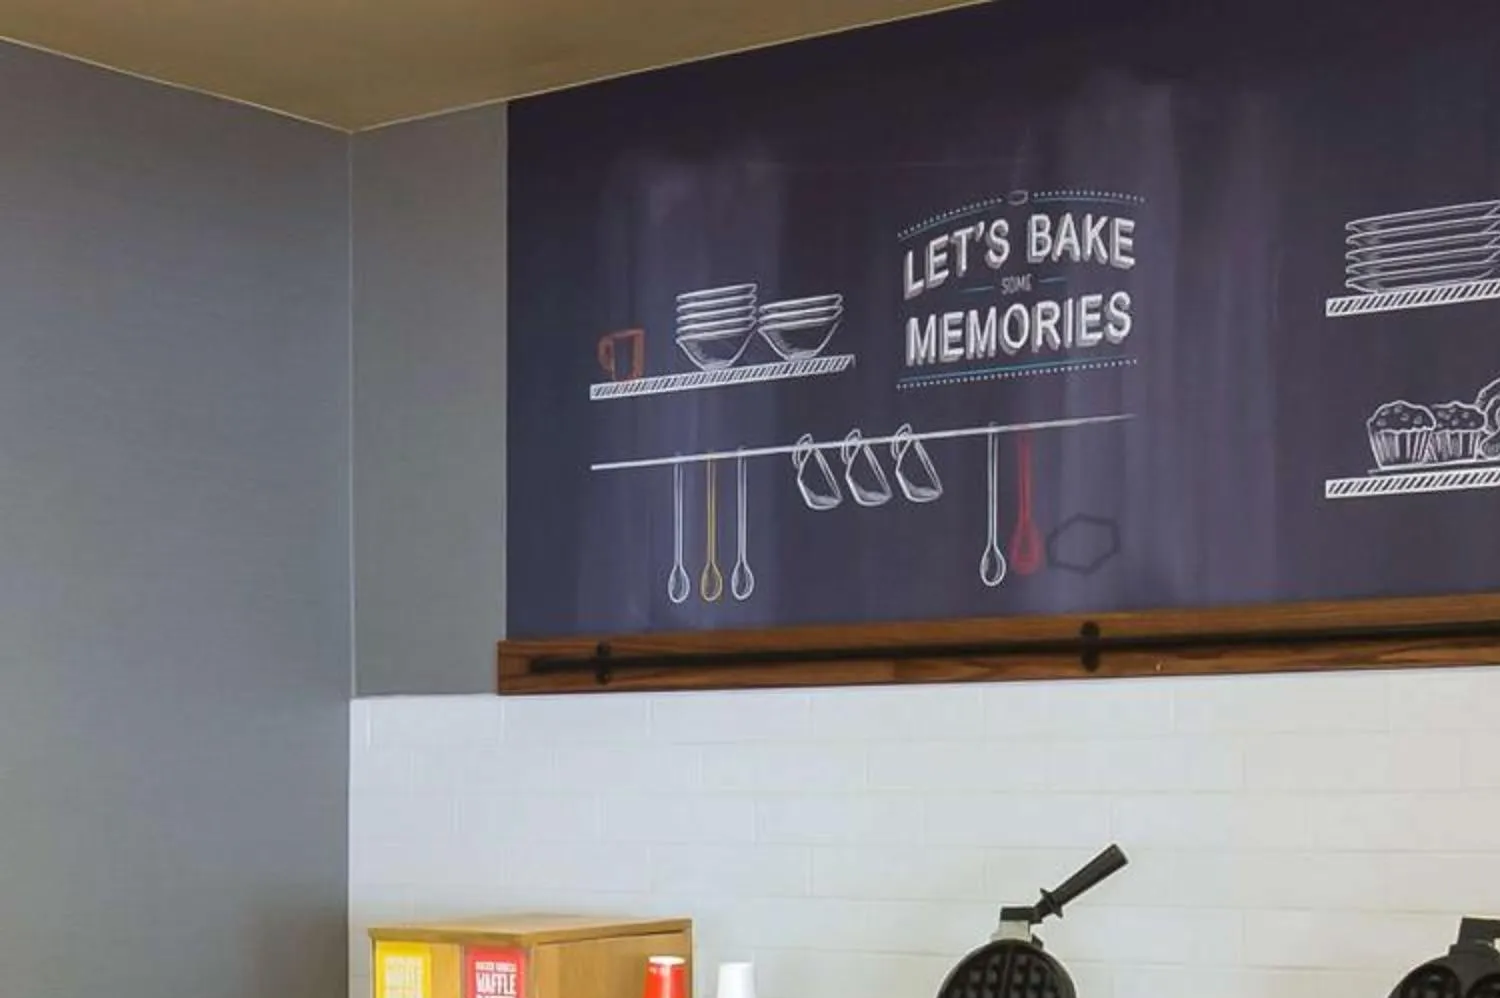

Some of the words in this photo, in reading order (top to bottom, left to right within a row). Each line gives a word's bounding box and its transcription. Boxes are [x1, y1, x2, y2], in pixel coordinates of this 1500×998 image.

[903, 219, 1011, 300] LET'S
[1027, 212, 1136, 269] BAKE
[1001, 273, 1032, 295] SOME
[906, 291, 1132, 367] MEMORIES
